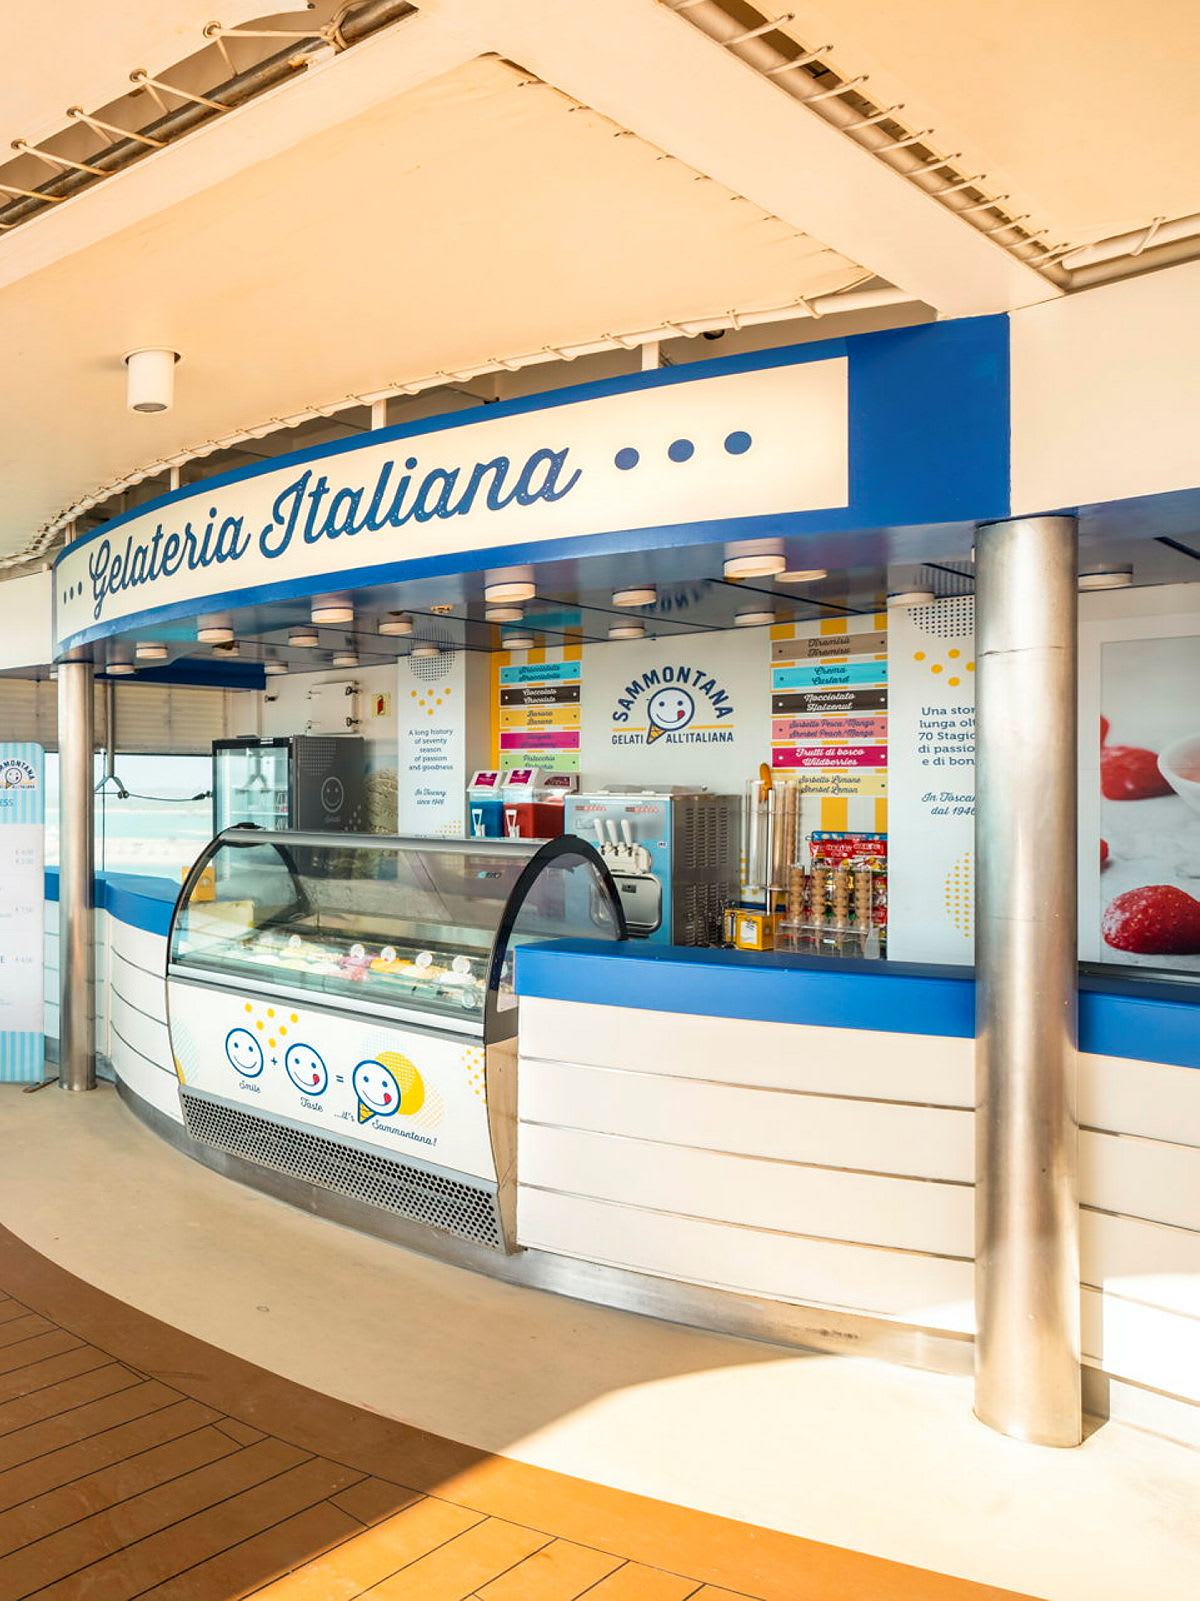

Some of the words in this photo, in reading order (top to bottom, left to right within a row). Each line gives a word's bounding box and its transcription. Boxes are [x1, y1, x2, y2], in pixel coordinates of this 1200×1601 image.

[89, 507, 251, 620] Gelateria
[259, 447, 583, 559] Italiana
[812, 675, 850, 685] Custard
[612, 666, 734, 722] SAMMONTANA
[922, 706, 947, 716] Una
[920, 719, 956, 729] lunga
[414, 729, 430, 738] long
[431, 728, 453, 736] history
[918, 732, 933, 741] 70
[611, 734, 644, 745] GELATI
[665, 732, 734, 744] ALL'ITALIANA
[795, 748, 823, 757] Frutti
[837, 748, 865, 756] bosco
[918, 745, 930, 753] di
[933, 757, 945, 766] di
[921, 792, 937, 802] In
[931, 806, 949, 815] dal
[239, 1079, 261, 1094] Smile
[300, 1096, 323, 1112] Taste
[371, 1119, 438, 1147] Sammontana!
